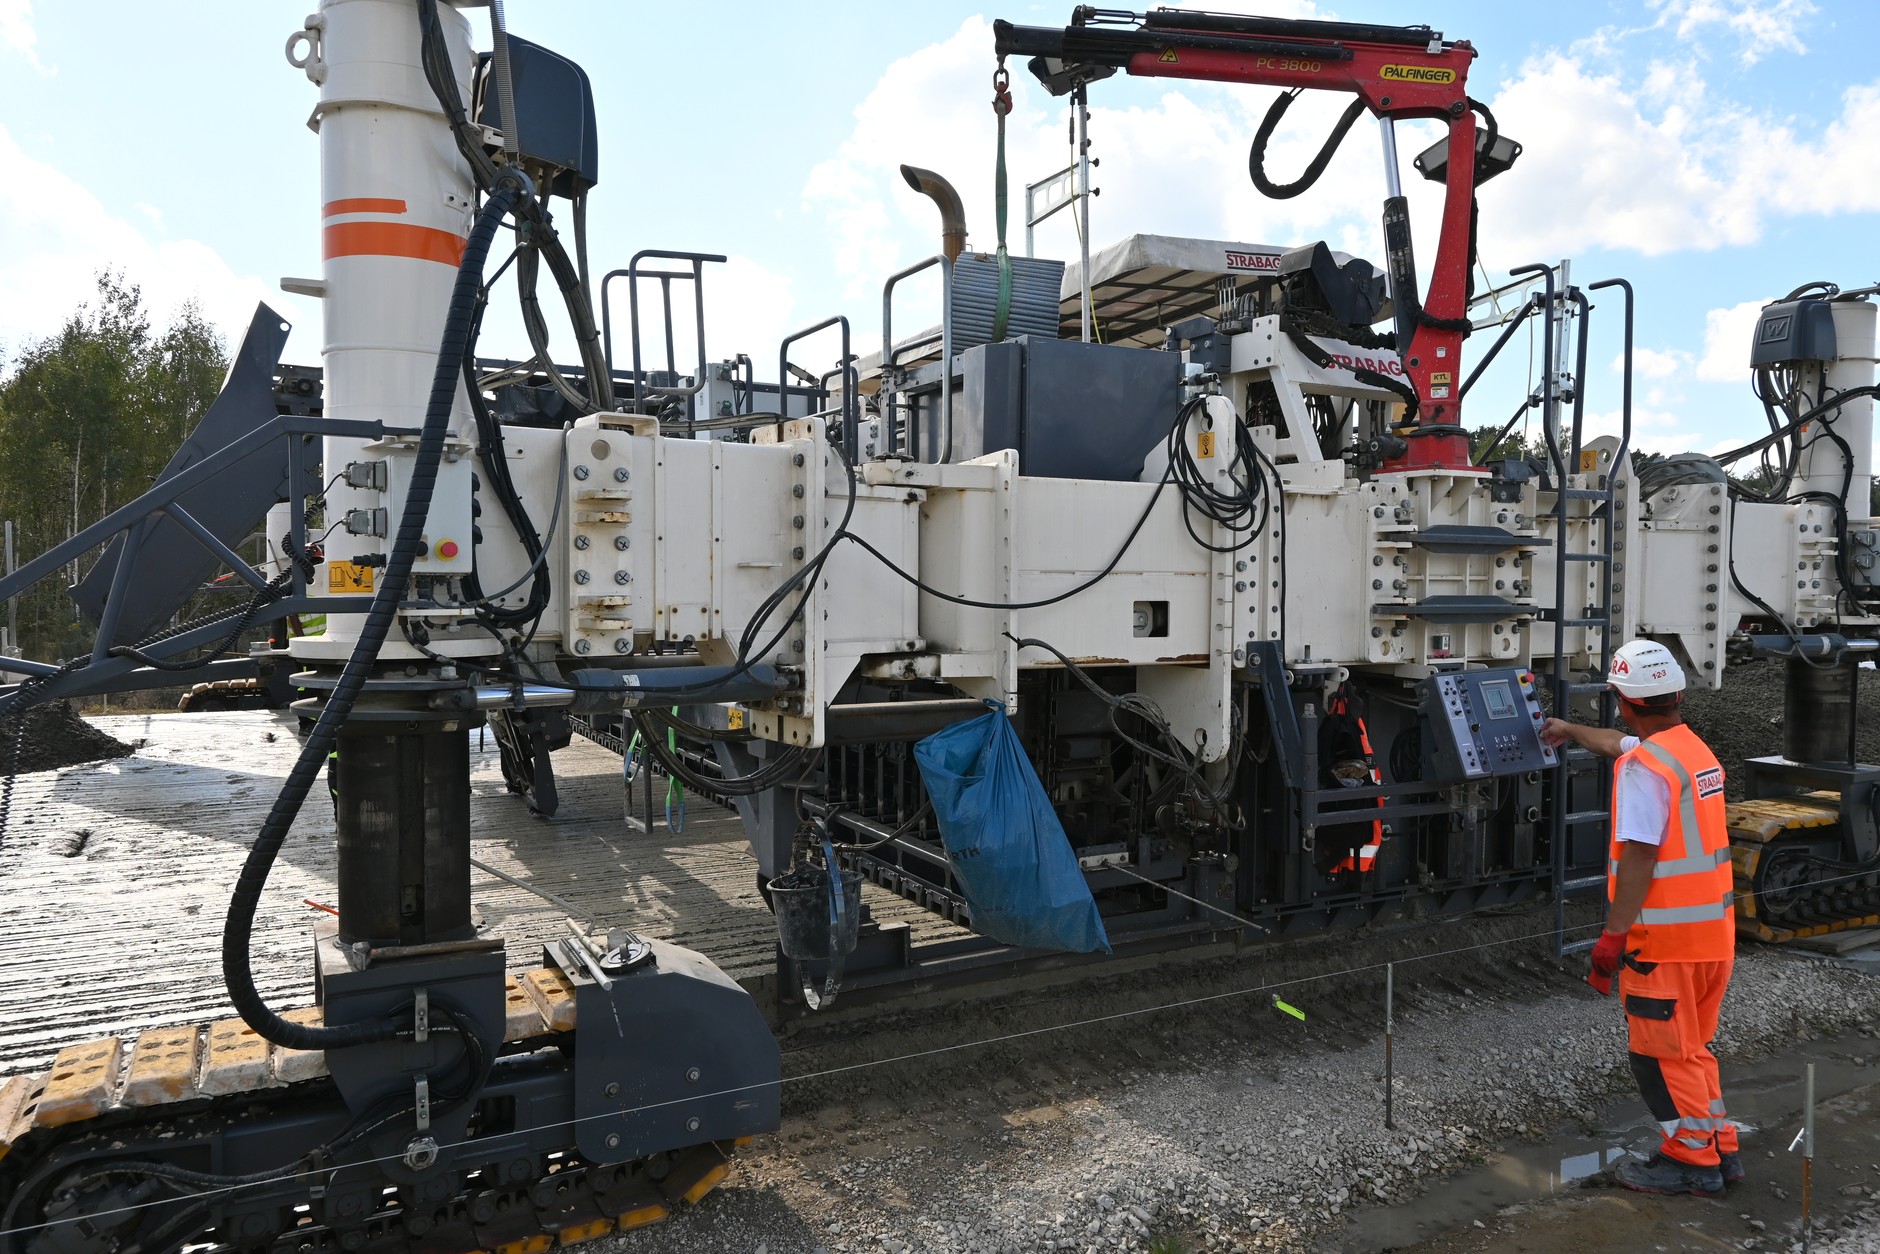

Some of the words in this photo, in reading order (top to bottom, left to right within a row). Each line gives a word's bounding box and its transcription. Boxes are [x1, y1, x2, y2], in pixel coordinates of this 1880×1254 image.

[1256, 57, 1275, 69] PC
[1280, 59, 1321, 73] 3800
[1384, 67, 1451, 82] PALFINGER
